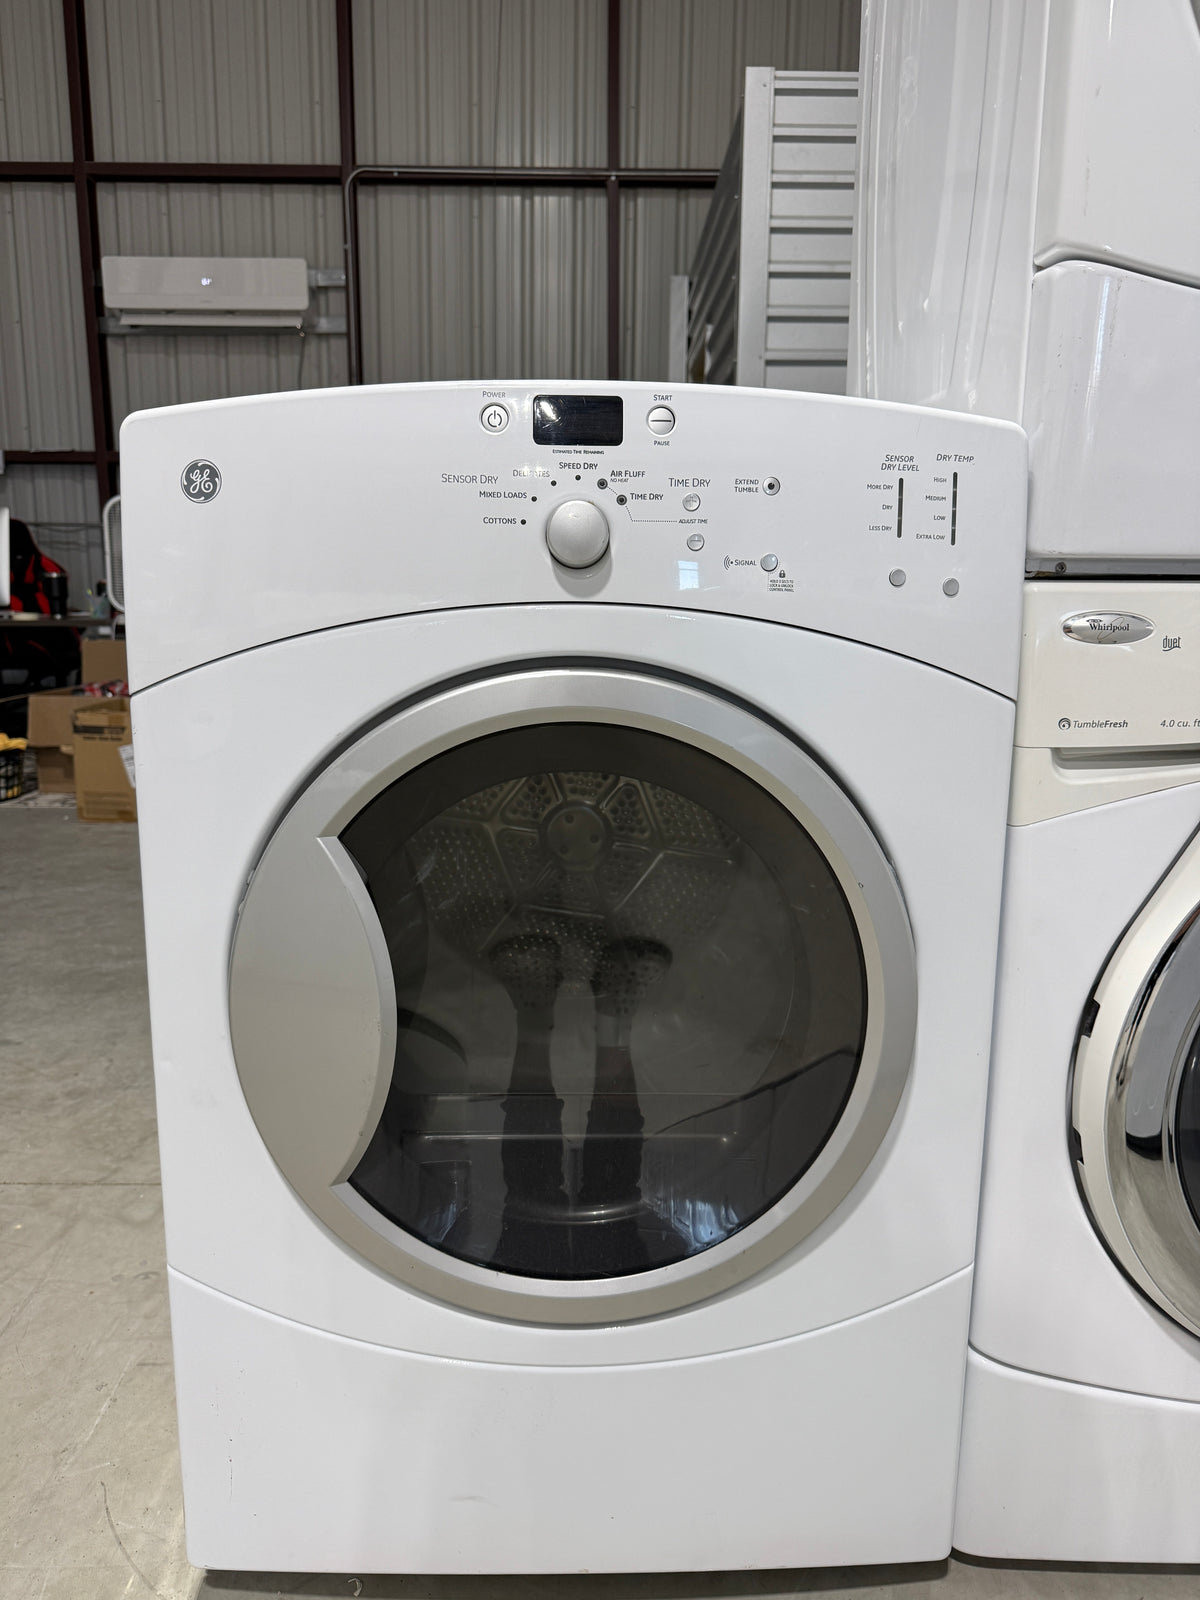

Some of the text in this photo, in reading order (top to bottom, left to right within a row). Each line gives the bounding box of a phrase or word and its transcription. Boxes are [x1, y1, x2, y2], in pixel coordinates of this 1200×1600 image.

[885, 454, 914, 462] SENSOR
[936, 454, 952, 462] DRY
[559, 462, 598, 471] SPEED DRY
[441, 474, 498, 484] SENSOR DRY
[669, 478, 710, 487] TIME DRY
[1089, 623, 1130, 633] Whirlpool
[1162, 636, 1182, 650] duet
[1073, 720, 1128, 728] TumbleFresh
[1160, 719, 1175, 727] 4.0
